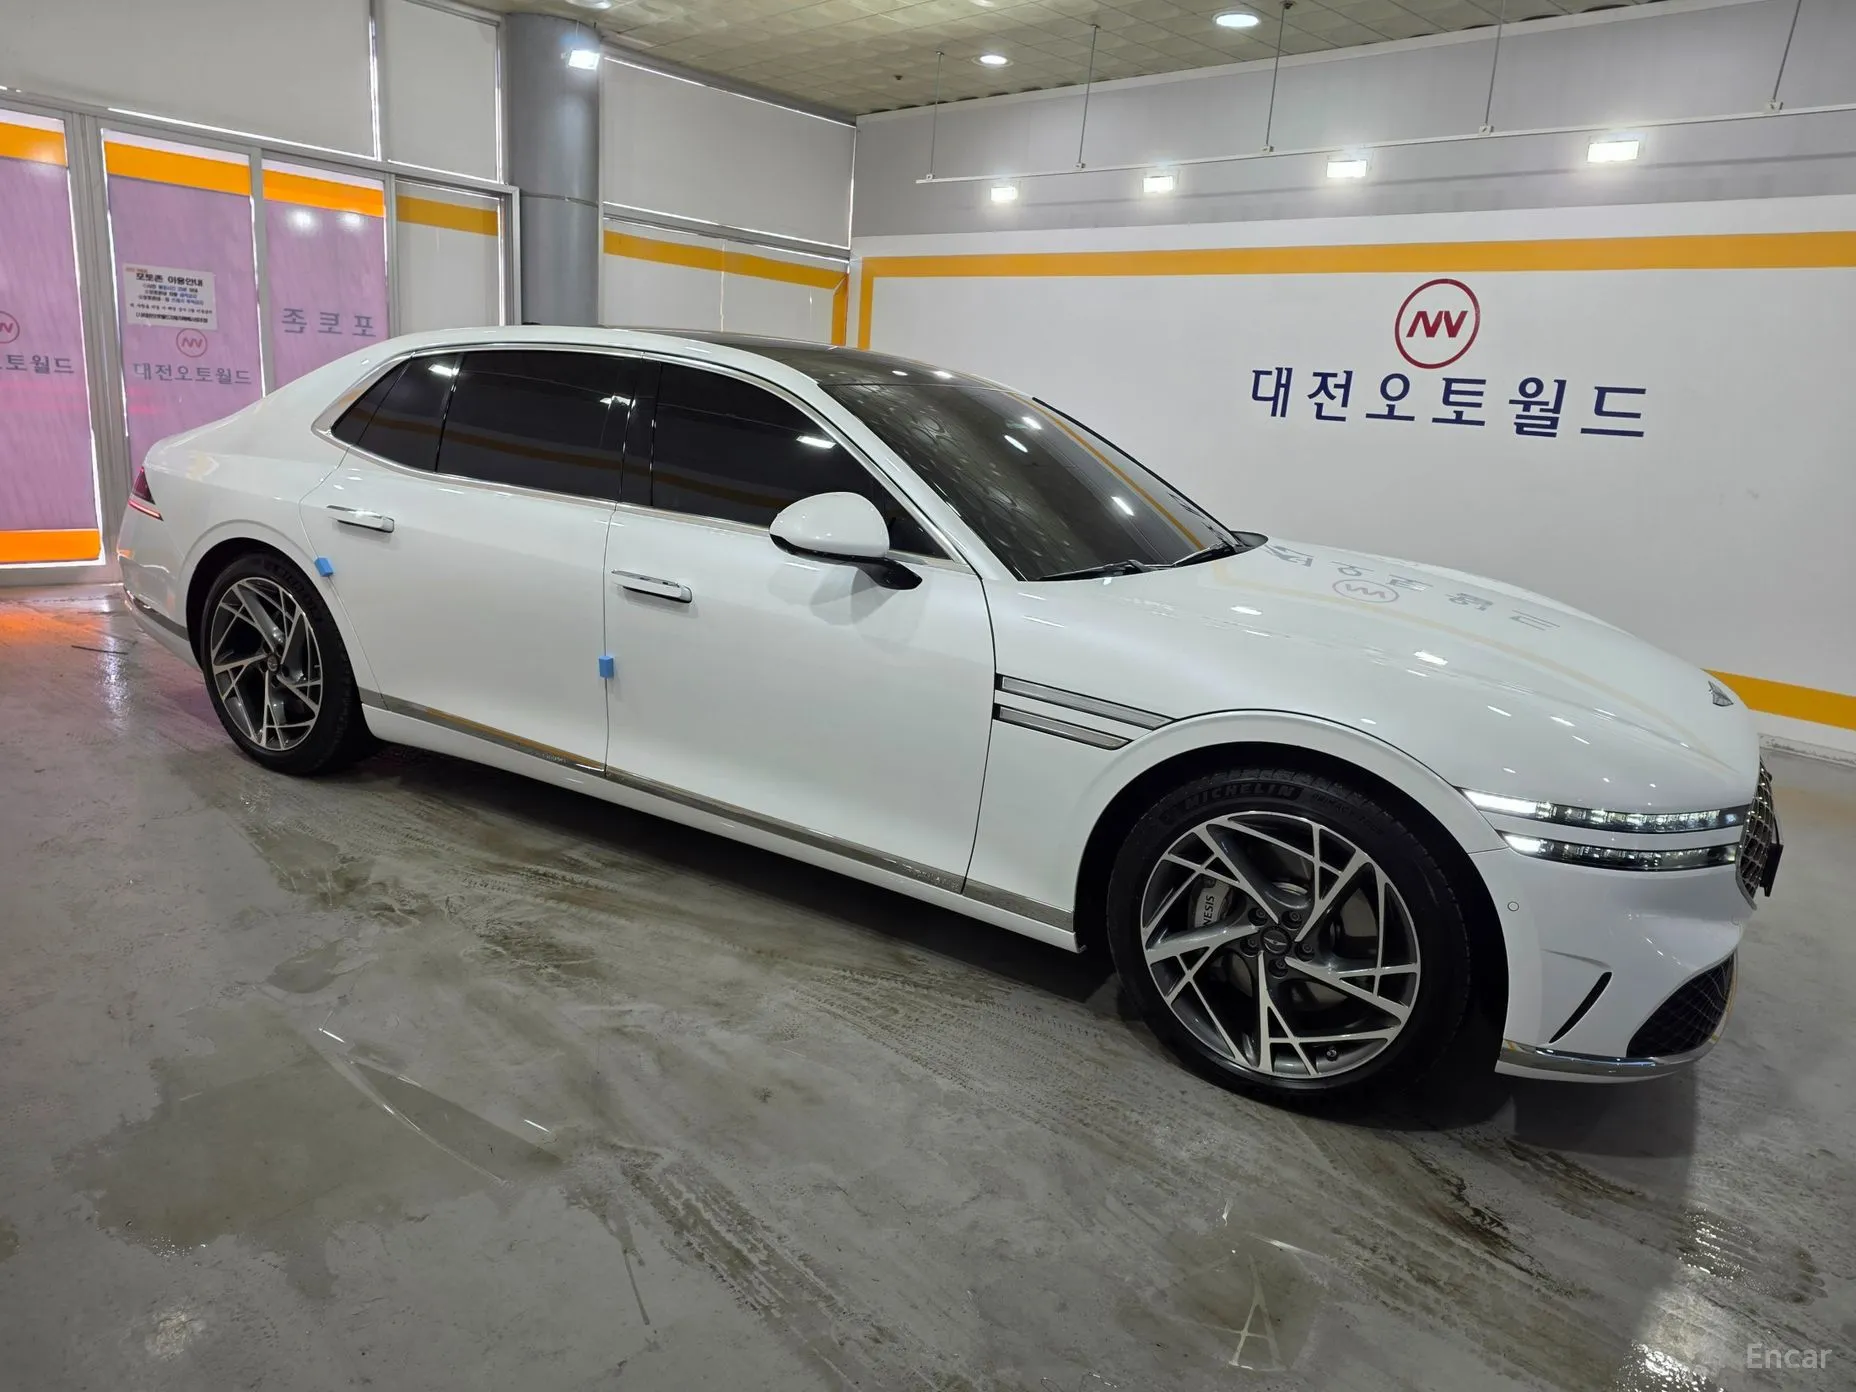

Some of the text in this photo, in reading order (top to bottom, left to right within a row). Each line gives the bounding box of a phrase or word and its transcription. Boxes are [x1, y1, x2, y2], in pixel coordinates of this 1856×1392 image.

[168, 275, 203, 287] 이용안내
[0, 354, 75, 375] 토월드
[133, 362, 252, 385] 대전오토월드
[1250, 366, 1648, 438] 대전오토월드
[1185, 783, 1294, 810] MICHELIN
